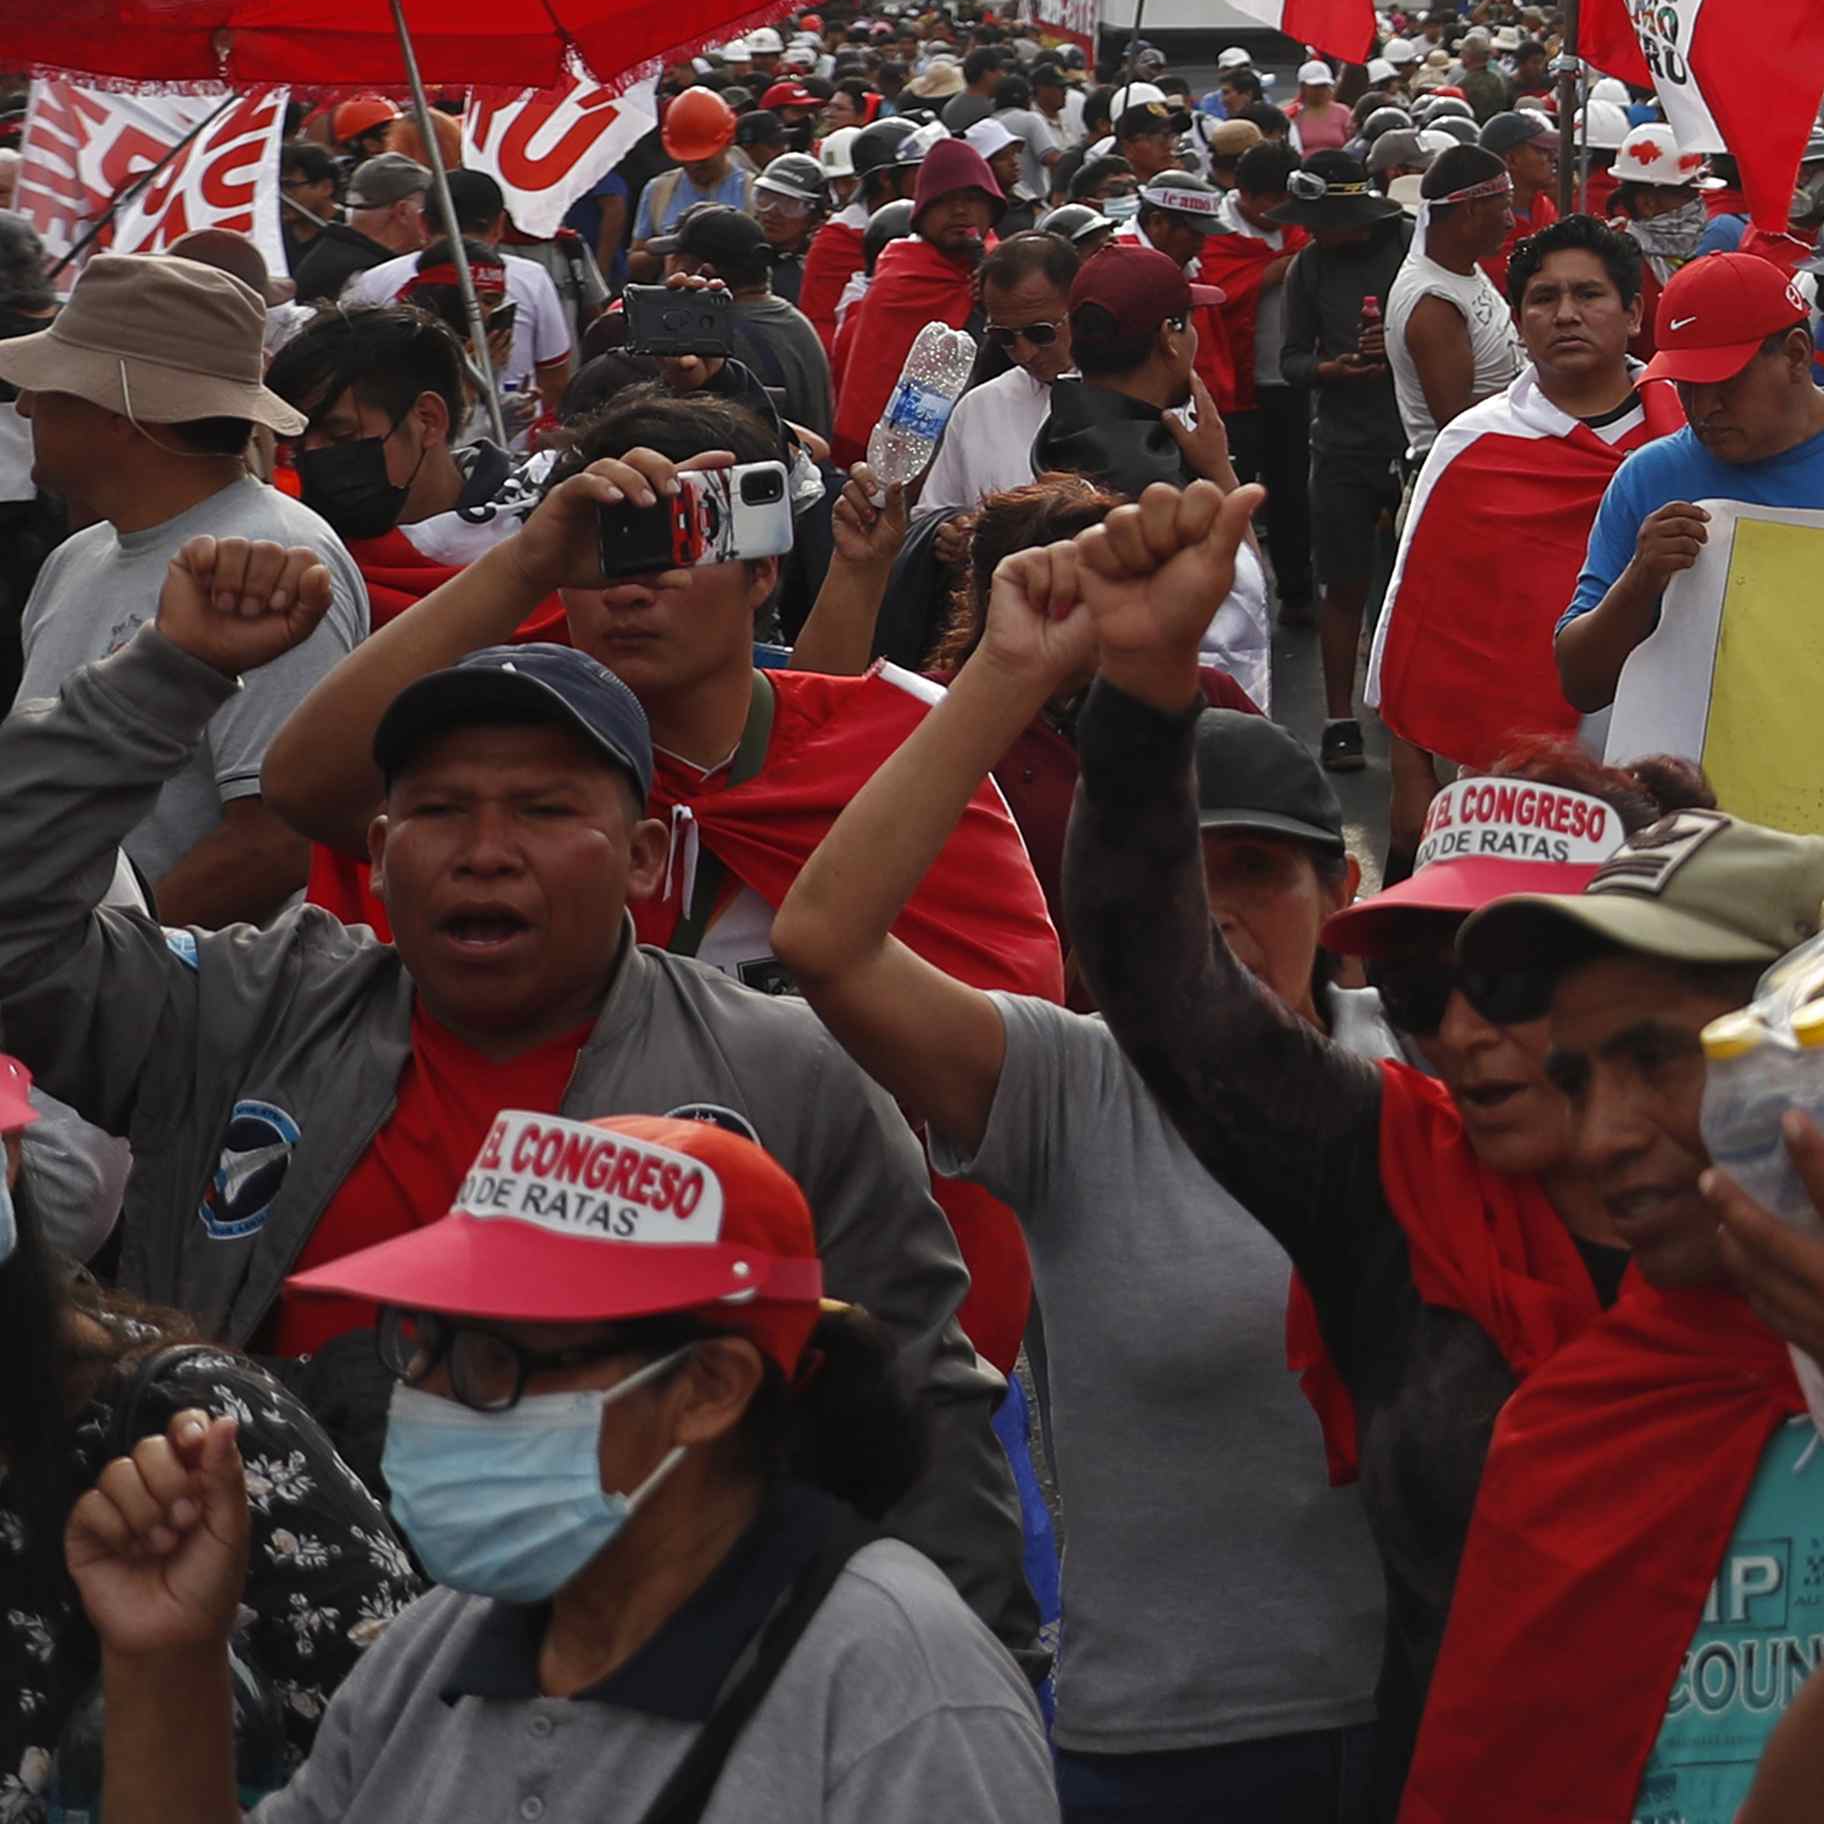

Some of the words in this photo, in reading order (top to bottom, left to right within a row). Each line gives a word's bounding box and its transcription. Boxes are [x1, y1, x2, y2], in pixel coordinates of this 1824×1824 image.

[1460, 784, 1607, 843] CONGRESO
[1441, 830, 1470, 854] DE
[1479, 829, 1570, 863] RATAS
[511, 1122, 705, 1220] CONGRESO
[475, 1176, 516, 1209] DE
[520, 1182, 639, 1238] RATAS
